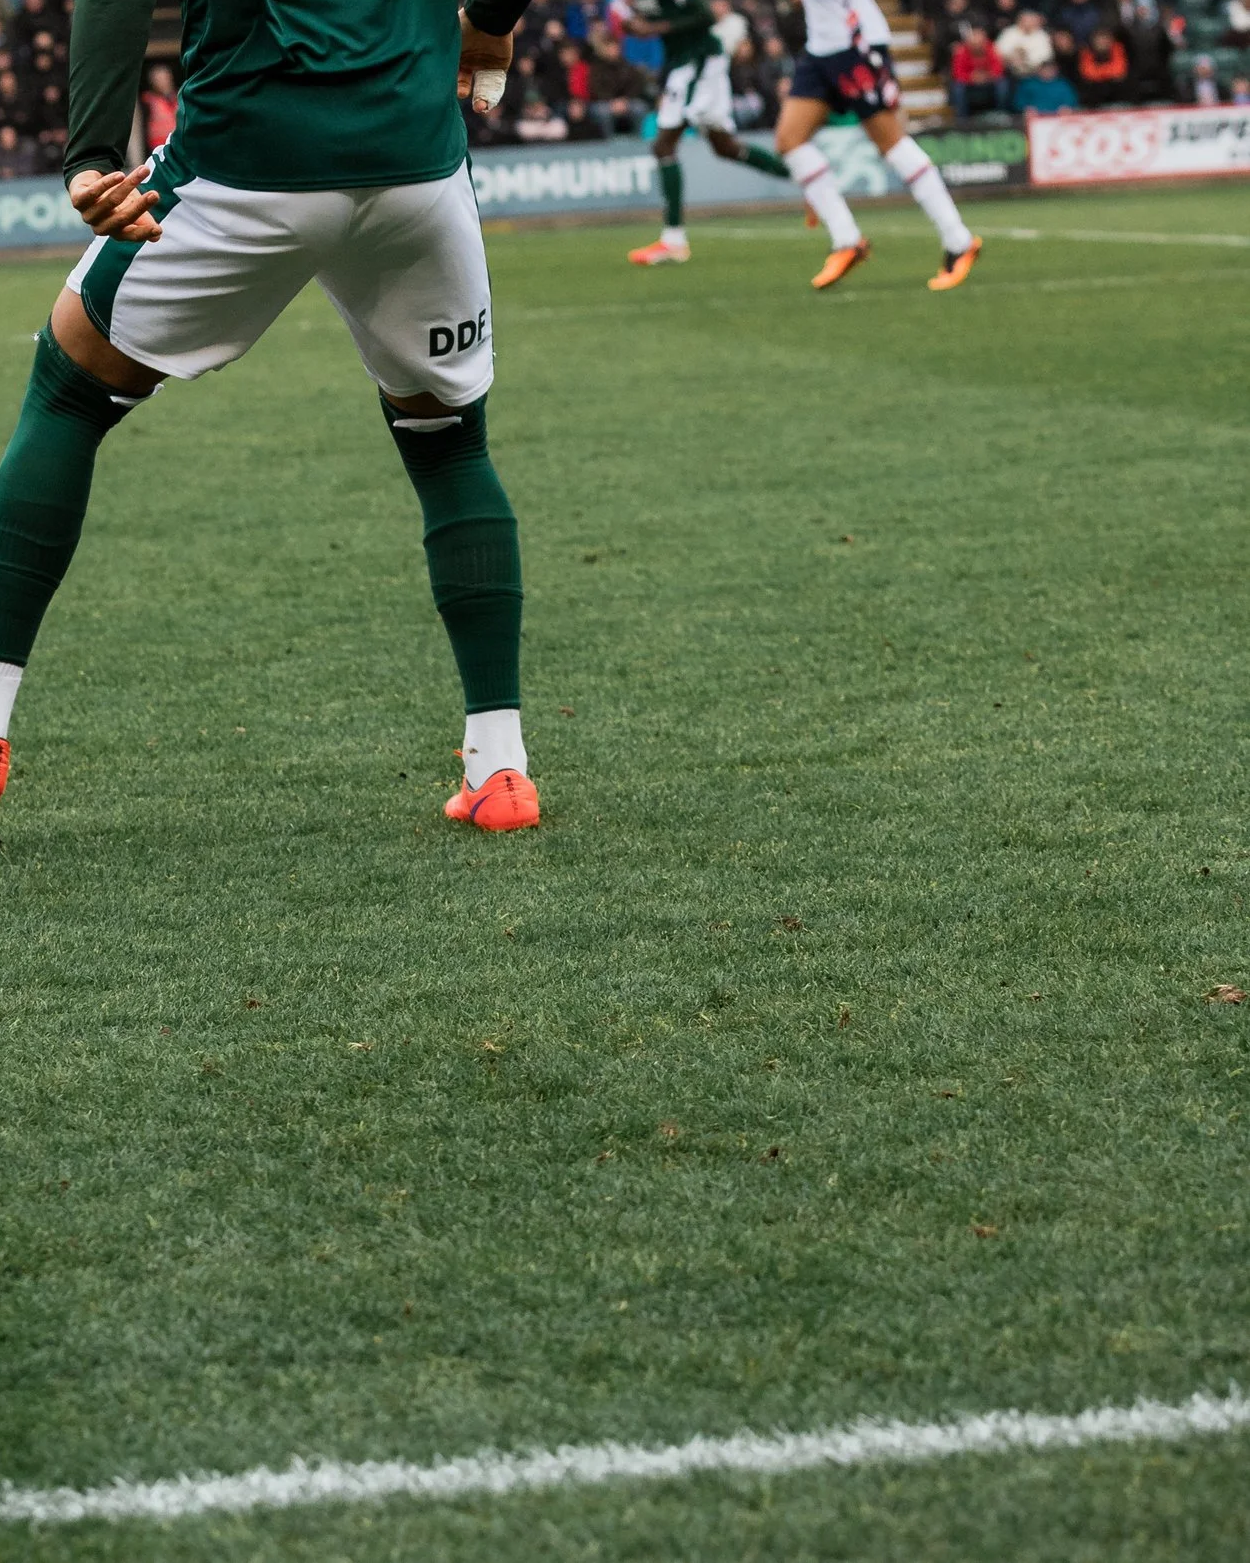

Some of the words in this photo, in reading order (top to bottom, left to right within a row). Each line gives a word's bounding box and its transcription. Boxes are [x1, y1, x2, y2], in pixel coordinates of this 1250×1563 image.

[1048, 122, 1155, 168] SOS
[472, 155, 658, 204] OMMUNIT
[429, 308, 487, 358] DDF
